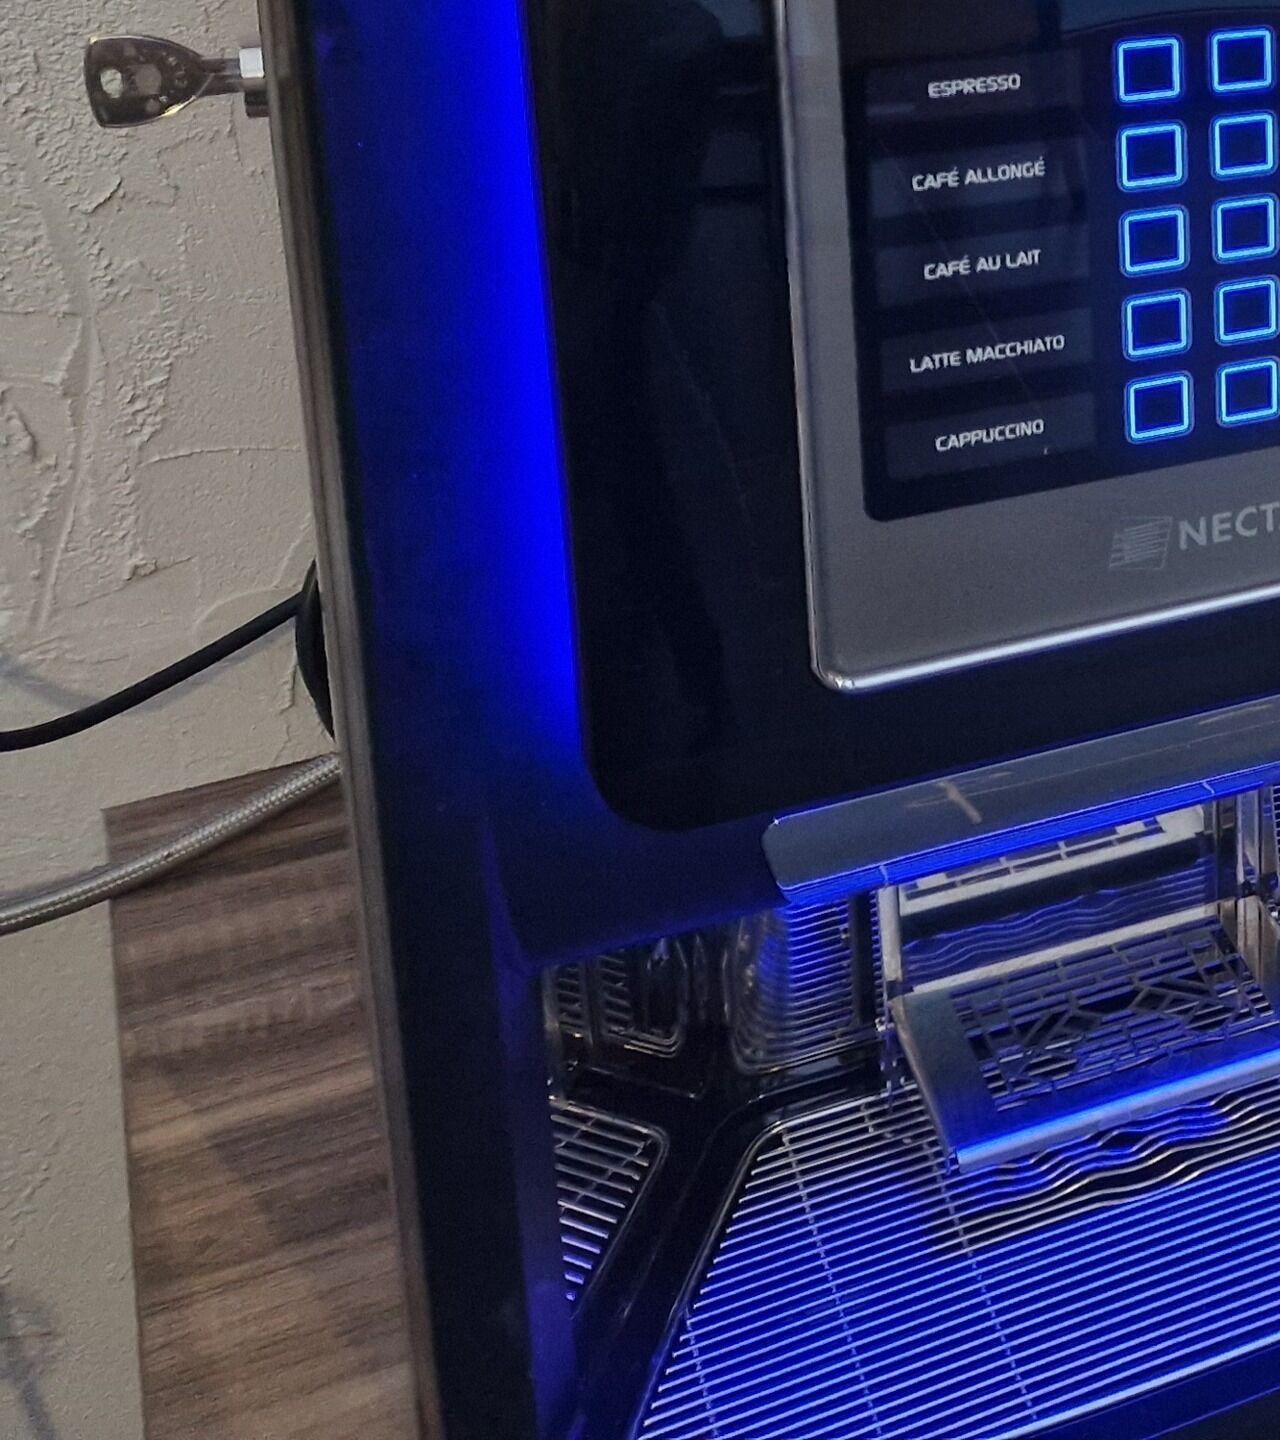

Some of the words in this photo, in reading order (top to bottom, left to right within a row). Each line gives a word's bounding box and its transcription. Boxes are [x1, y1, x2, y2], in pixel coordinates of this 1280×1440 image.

[927, 73, 1021, 98] ESPRESSO
[912, 166, 960, 191] CAFÉ
[964, 156, 1046, 185] ALLONGÉ
[923, 254, 971, 280] CAFÉ
[975, 255, 1001, 273] AU
[1005, 249, 1041, 269] LAIT
[909, 351, 961, 373] LATTE
[965, 334, 1065, 365] MACCHIATO
[935, 418, 1045, 451] CAPPUCCINO
